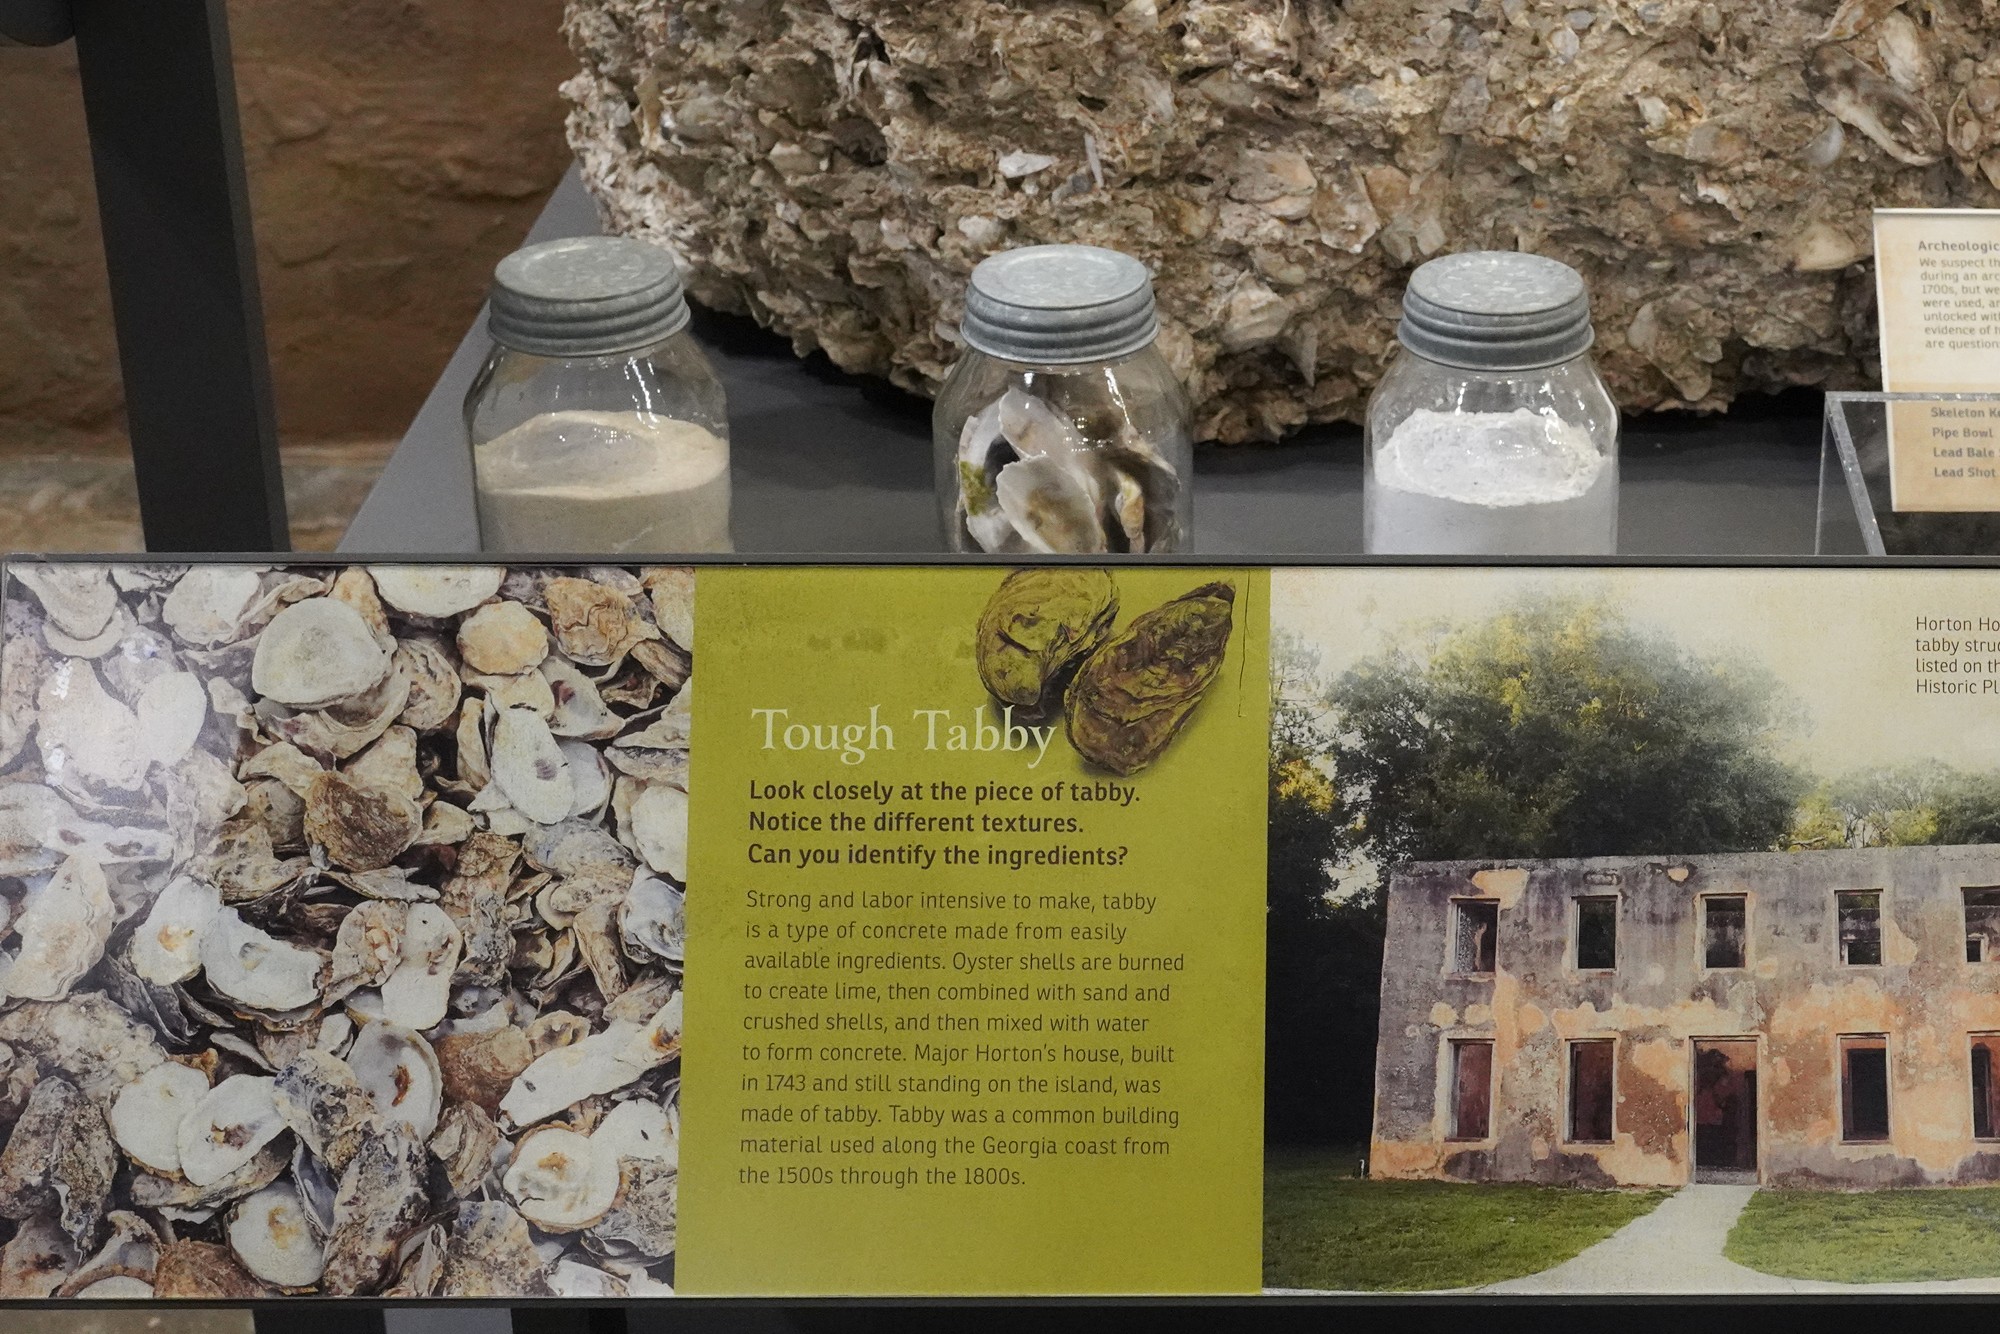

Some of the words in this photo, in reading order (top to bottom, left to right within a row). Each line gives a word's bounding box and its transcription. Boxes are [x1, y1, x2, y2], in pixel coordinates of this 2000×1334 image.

[1918, 240, 2000, 254] Archeologic
[1919, 258, 1937, 268] We
[1941, 258, 1985, 269] suspect
[1920, 271, 1959, 283] during
[1963, 272, 1978, 281] an
[1922, 284, 1958, 296] 1700s,
[1961, 285, 1981, 295] but
[1922, 299, 1951, 308] were
[1954, 298, 1985, 309] used,
[1923, 311, 1977, 321] unlocked
[1980, 312, 2000, 321] wit
[1924, 325, 1976, 335] evidence
[1979, 325, 1991, 335] of
[1925, 340, 1945, 349] are
[1948, 339, 2000, 351] question
[1931, 406, 1985, 418] Skeleton
[1932, 427, 1959, 440] Pipe
[1963, 427, 1993, 438] Bowl
[1933, 447, 1963, 458] Lead
[1967, 447, 1995, 458] Bale
[1934, 466, 1964, 478] Lead
[1967, 466, 1996, 478] Shot
[1916, 616, 1972, 631] Horton
[1979, 616, 2000, 632] Ho
[1916, 637, 1960, 656] tabby
[1916, 658, 1958, 673] listed
[1963, 661, 1982, 673] on
[1916, 679, 1977, 694] Historic
[1983, 679, 2000, 694] Pl
[751, 703, 896, 766] Tough
[913, 704, 1057, 769] Tabby
[750, 779, 806, 800] Look
[812, 780, 894, 806] closely
[900, 781, 924, 801] at
[929, 780, 967, 801] the
[975, 780, 1034, 807] piece
[1040, 780, 1066, 802] of
[1069, 780, 1141, 808] tabby.
[749, 810, 822, 832] Notice
[829, 811, 866, 832] the
[873, 811, 975, 833] different
[981, 813, 1084, 833] textures.
[748, 843, 791, 864] Can
[796, 848, 840, 870] you
[848, 843, 937, 871] identify
[943, 844, 980, 865] the
[988, 844, 1129, 871] ingredients?
[746, 889, 812, 913] Strong
[818, 890, 854, 909] and
[862, 890, 914, 909] labor
[920, 891, 1007, 910] intensive
[1013, 893, 1032, 910] to
[1039, 891, 1096, 914] make,
[1102, 891, 1157, 915] tabby
[746, 920, 761, 939] is
[767, 923, 780, 939] a
[786, 922, 829, 944] type
[836, 920, 857, 939] of
[862, 923, 948, 940] concrete
[955, 921, 1009, 940] made
[1015, 921, 1062, 940] from
[1070, 922, 1128, 946] easily
[744, 951, 831, 970] available
[837, 951, 946, 975] ingredients.
[952, 951, 1014, 975] Oyster
[1019, 952, 1076, 971] shells
[1081, 956, 1112, 971] are
[1118, 952, 1185, 972] burned
[743, 983, 762, 1000] to
[768, 983, 829, 1000] create
[834, 981, 881, 1004] lime,
[887, 981, 930, 1001] then
[937, 982, 1030, 1001] combined
[1036, 983, 1076, 1002] with
[1082, 983, 1128, 1002] sand
[1134, 983, 1170, 1002] and
[743, 1012, 819, 1031] crushed
[825, 1012, 888, 1035] shells,
[894, 1012, 930, 1032] and
[936, 1012, 980, 1032] then
[987, 1013, 1043, 1032] mixed
[1049, 1013, 1089, 1032] with
[1096, 1016, 1151, 1033] water
[742, 1044, 761, 1061] to
[766, 1042, 813, 1062] form
[819, 1044, 907, 1062] concrete.
[914, 1043, 970, 1067] Major
[976, 1042, 1056, 1063] Horton's
[1063, 1044, 1124, 1067] house,
[1131, 1044, 1175, 1064] built
[741, 1073, 759, 1092] in
[765, 1073, 806, 1092] 1743
[812, 1073, 848, 1092] and
[854, 1073, 892, 1093] still
[898, 1074, 981, 1098] standing
[987, 1078, 1011, 1093] on
[1017, 1074, 1049, 1094] the
[1055, 1074, 1118, 1097] island,
[1124, 1079, 1161, 1094] was
[741, 1103, 794, 1123] made
[800, 1104, 821, 1123] of
[824, 1104, 882, 1128] tabby.
[888, 1104, 946, 1128] Tabby
[951, 1108, 988, 1124] was
[994, 1109, 1006, 1124] a
[1012, 1108, 1095, 1124] common
[1102, 1105, 1179, 1130] building
[740, 1134, 823, 1154] material
[830, 1135, 875, 1154] used
[881, 1135, 937, 1159] along
[944, 1135, 976, 1155] the
[982, 1135, 1058, 1159] Georgia
[1064, 1138, 1118, 1156] coast
[1122, 1136, 1170, 1155] from
[738, 1165, 770, 1185] the
[776, 1166, 834, 1185] 1500s
[840, 1165, 918, 1190] through
[925, 1166, 957, 1185] the
[964, 1167, 1026, 1186] 1800s.
